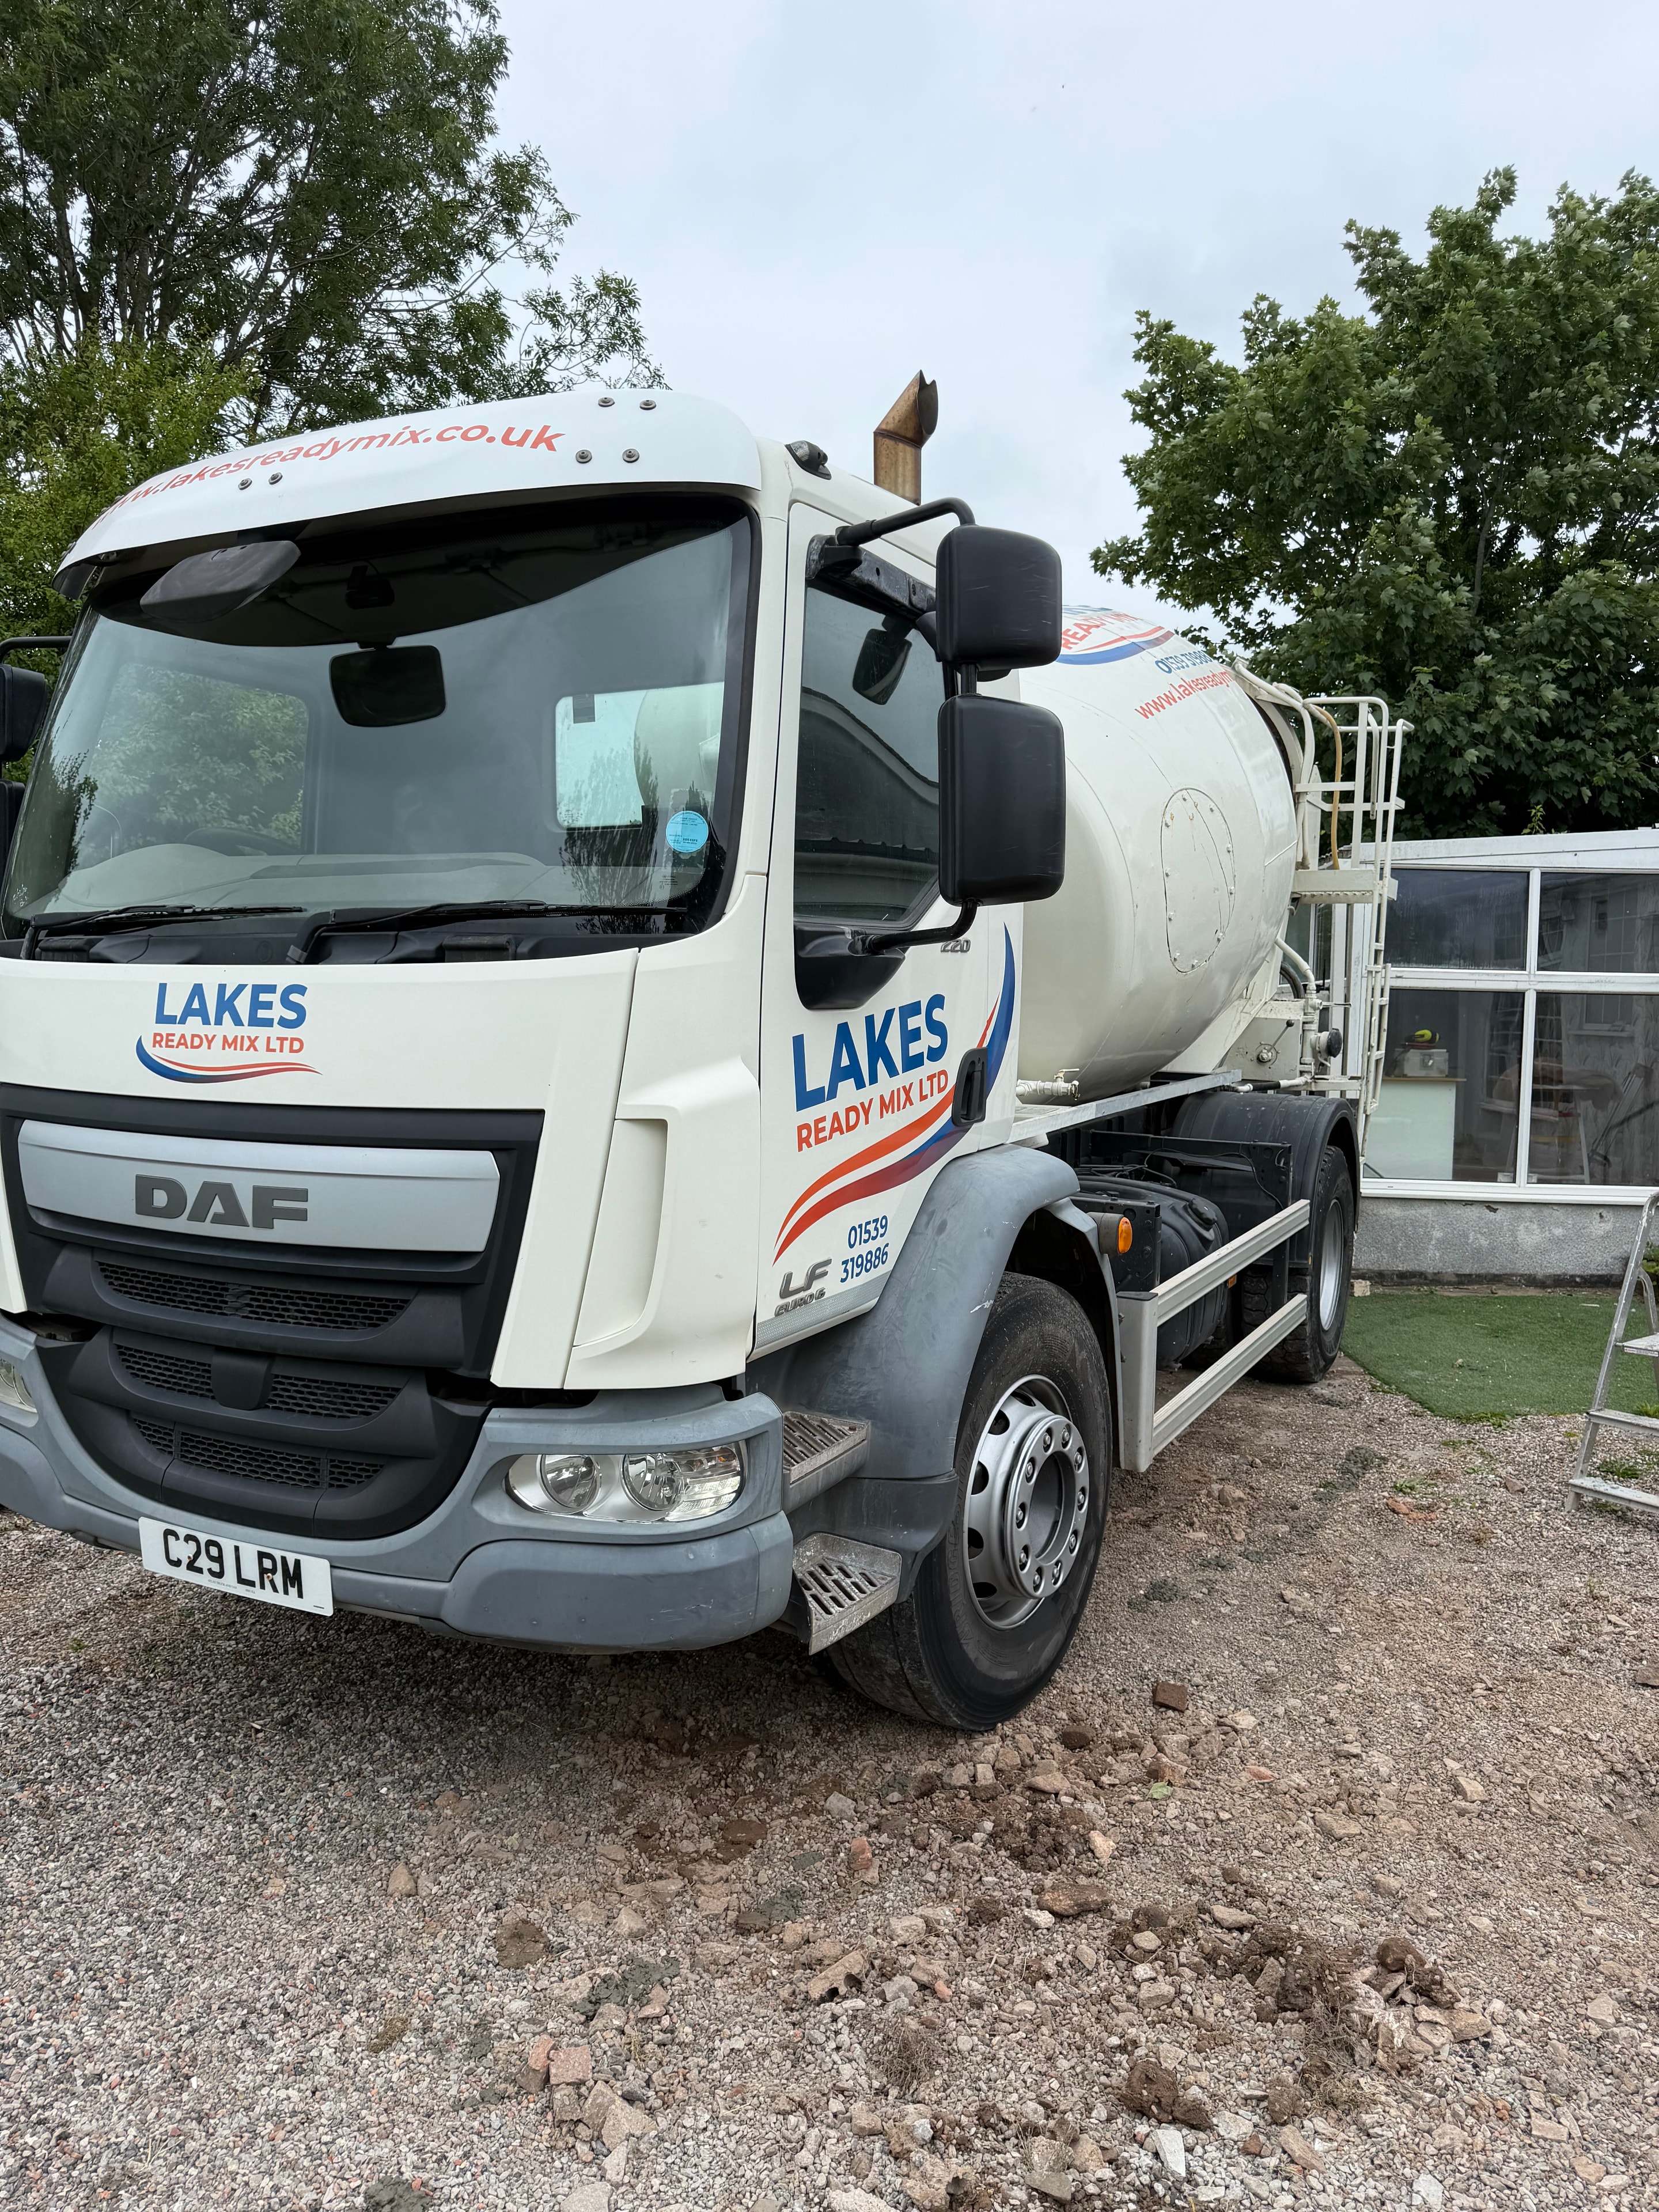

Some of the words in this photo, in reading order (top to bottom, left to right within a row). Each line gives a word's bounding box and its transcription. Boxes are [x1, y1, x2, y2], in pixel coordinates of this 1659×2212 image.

[940, 938, 971, 953] 220
[155, 982, 308, 1029] LAKES
[152, 1032, 217, 1050] READY
[222, 1035, 260, 1052] MIX
[266, 1036, 304, 1054] LTD
[792, 994, 948, 1112] LAKES
[797, 1097, 874, 1153] READY
[880, 1082, 914, 1119] MIX
[919, 1069, 949, 1103] LTD
[135, 1174, 308, 1229] DAF
[848, 1215, 888, 1249] 01539
[779, 1257, 832, 1300] LF
[840, 1243, 889, 1283] 319886
[162, 1528, 225, 1580] C29
[233, 1544, 304, 1600] LRM
